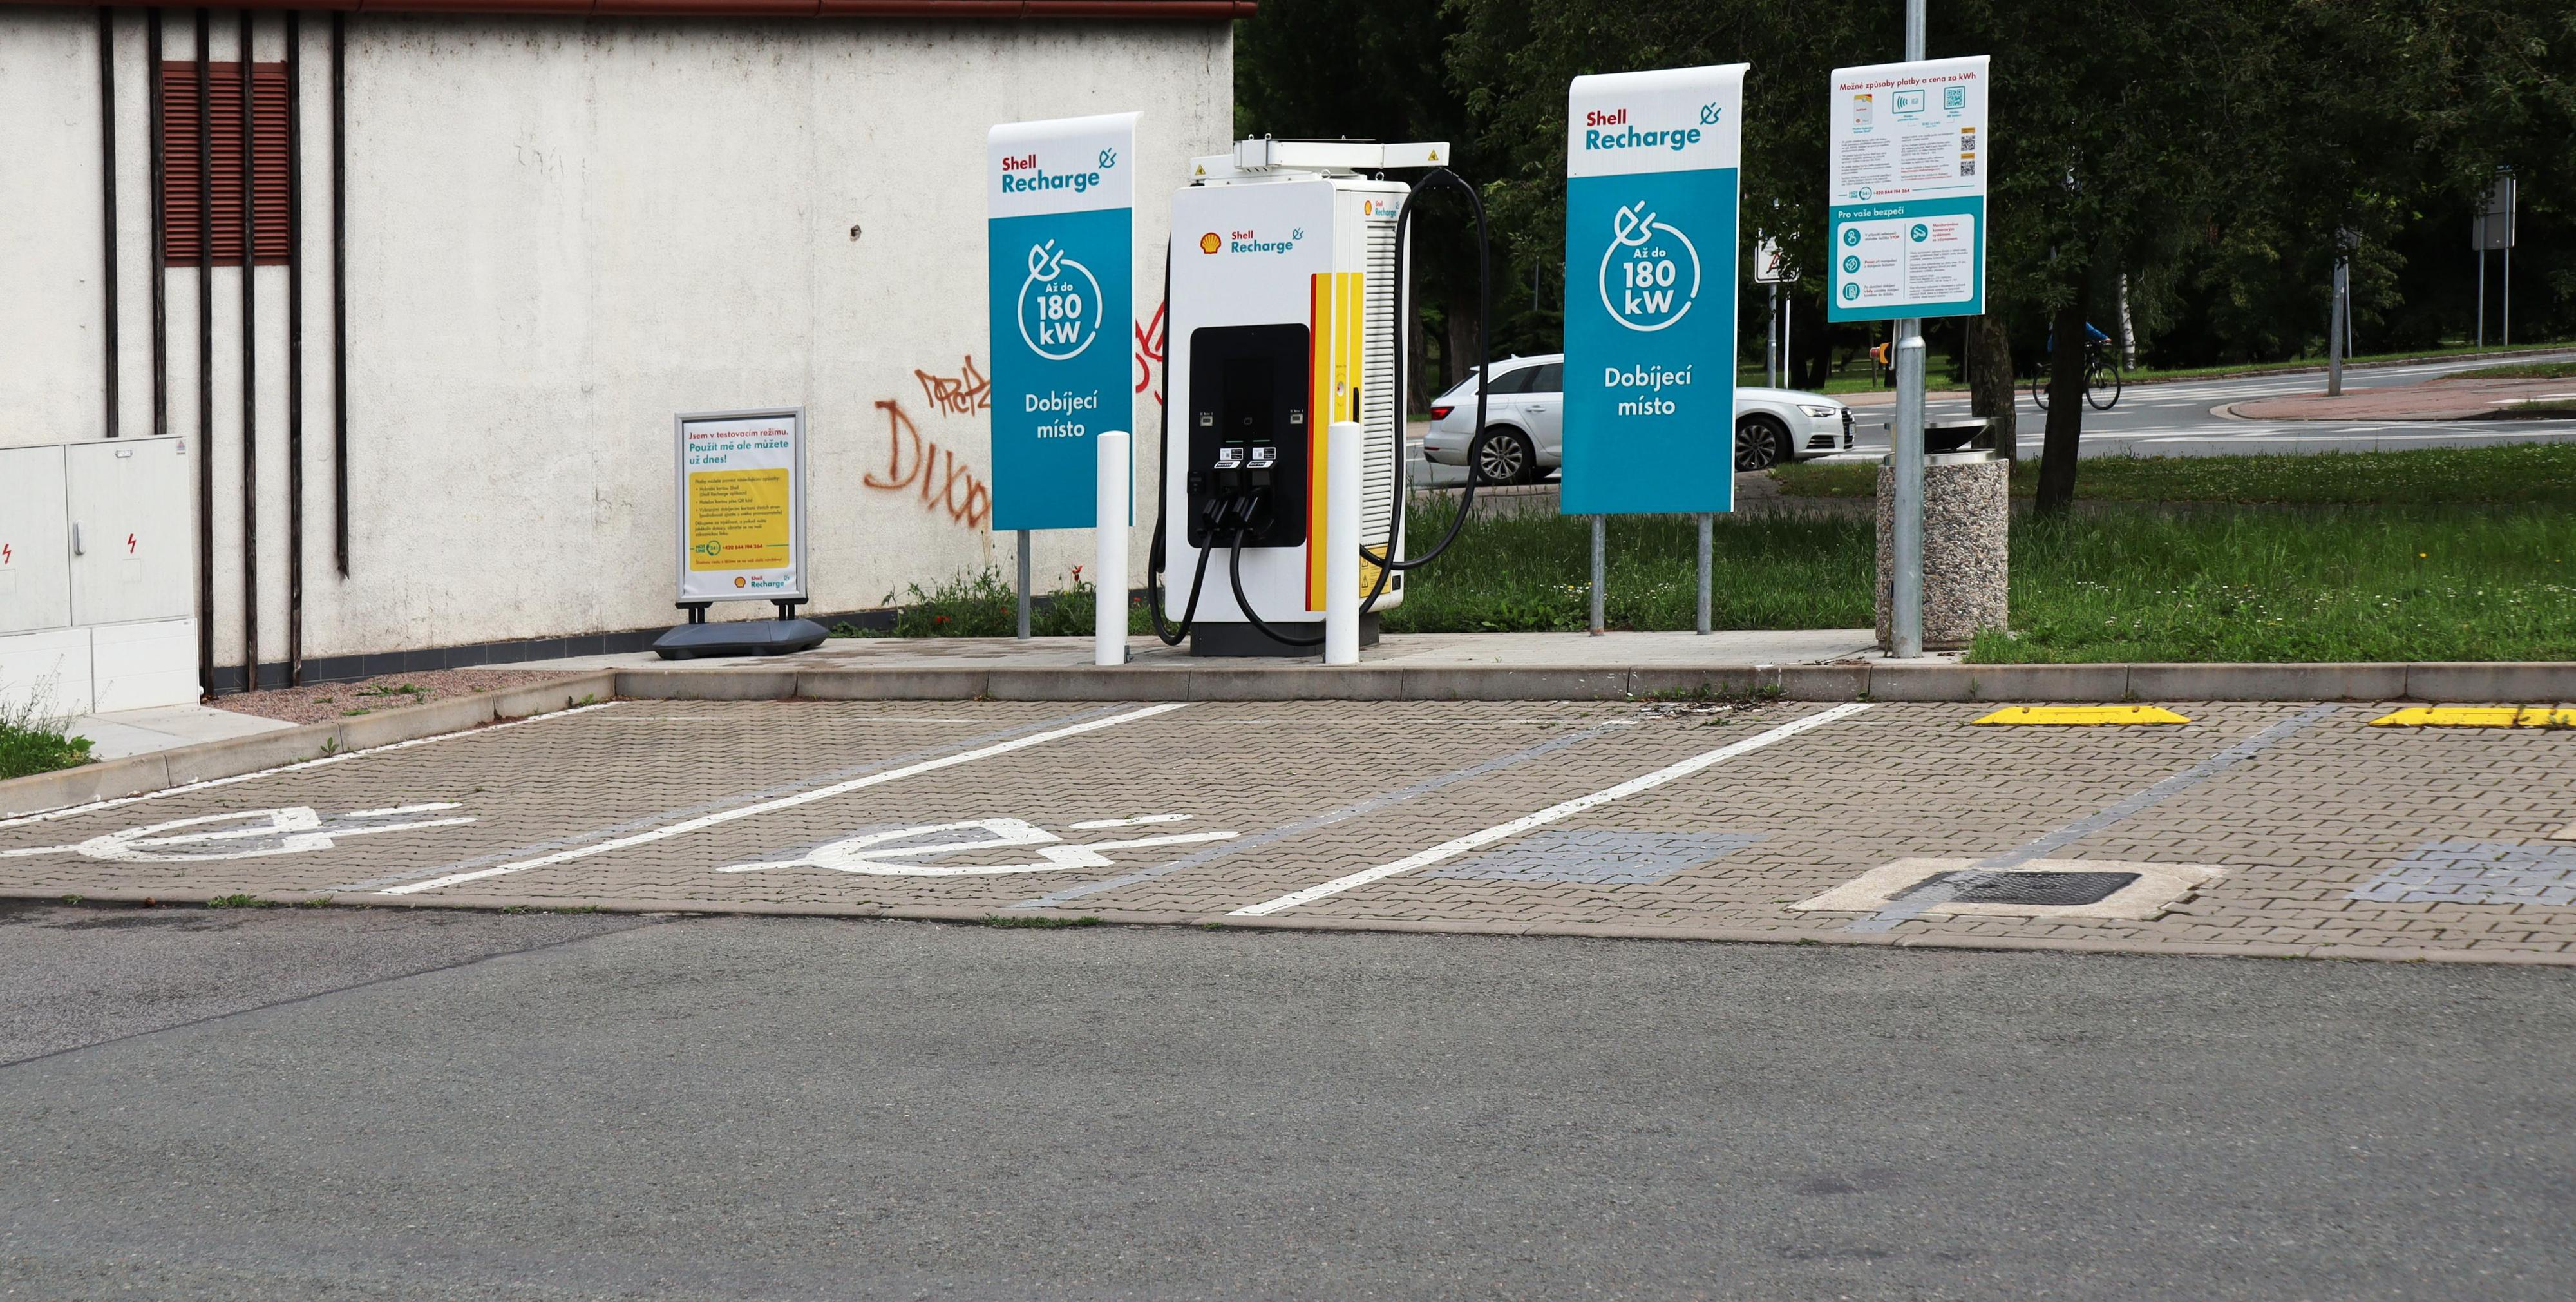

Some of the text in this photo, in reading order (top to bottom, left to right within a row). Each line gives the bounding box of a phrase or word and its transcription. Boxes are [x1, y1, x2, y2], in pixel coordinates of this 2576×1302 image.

[1866, 80, 1895, 90] způsoby
[1897, 77, 1920, 87] platby
[1959, 72, 1976, 81] kWh
[1587, 109, 1626, 126] Shell
[1586, 125, 1701, 151] Recharge
[1002, 155, 1036, 171] Shell
[1002, 169, 1099, 193] Recharge
[1375, 207, 1396, 218] Recharge
[1853, 209, 1871, 217] vaše
[1873, 206, 1904, 217] bezpečí
[1231, 230, 1253, 240] Shell
[1231, 240, 1293, 254] Recharge
[1633, 247, 1666, 258] Až do
[1624, 260, 1675, 287] 180
[1046, 282, 1073, 293] Až do
[1037, 294, 1082, 321] 180
[1625, 290, 1674, 314] kW
[1040, 321, 1081, 345] kW
[1605, 365, 1692, 391] Dobíjecí
[1025, 390, 1098, 415] Dobíjecí
[1619, 396, 1675, 415] místo
[717, 429, 758, 438] testovacím
[1037, 420, 1085, 439] místo
[690, 439, 789, 452] Použít mě ale můžete
[690, 454, 727, 464] už dnes!
